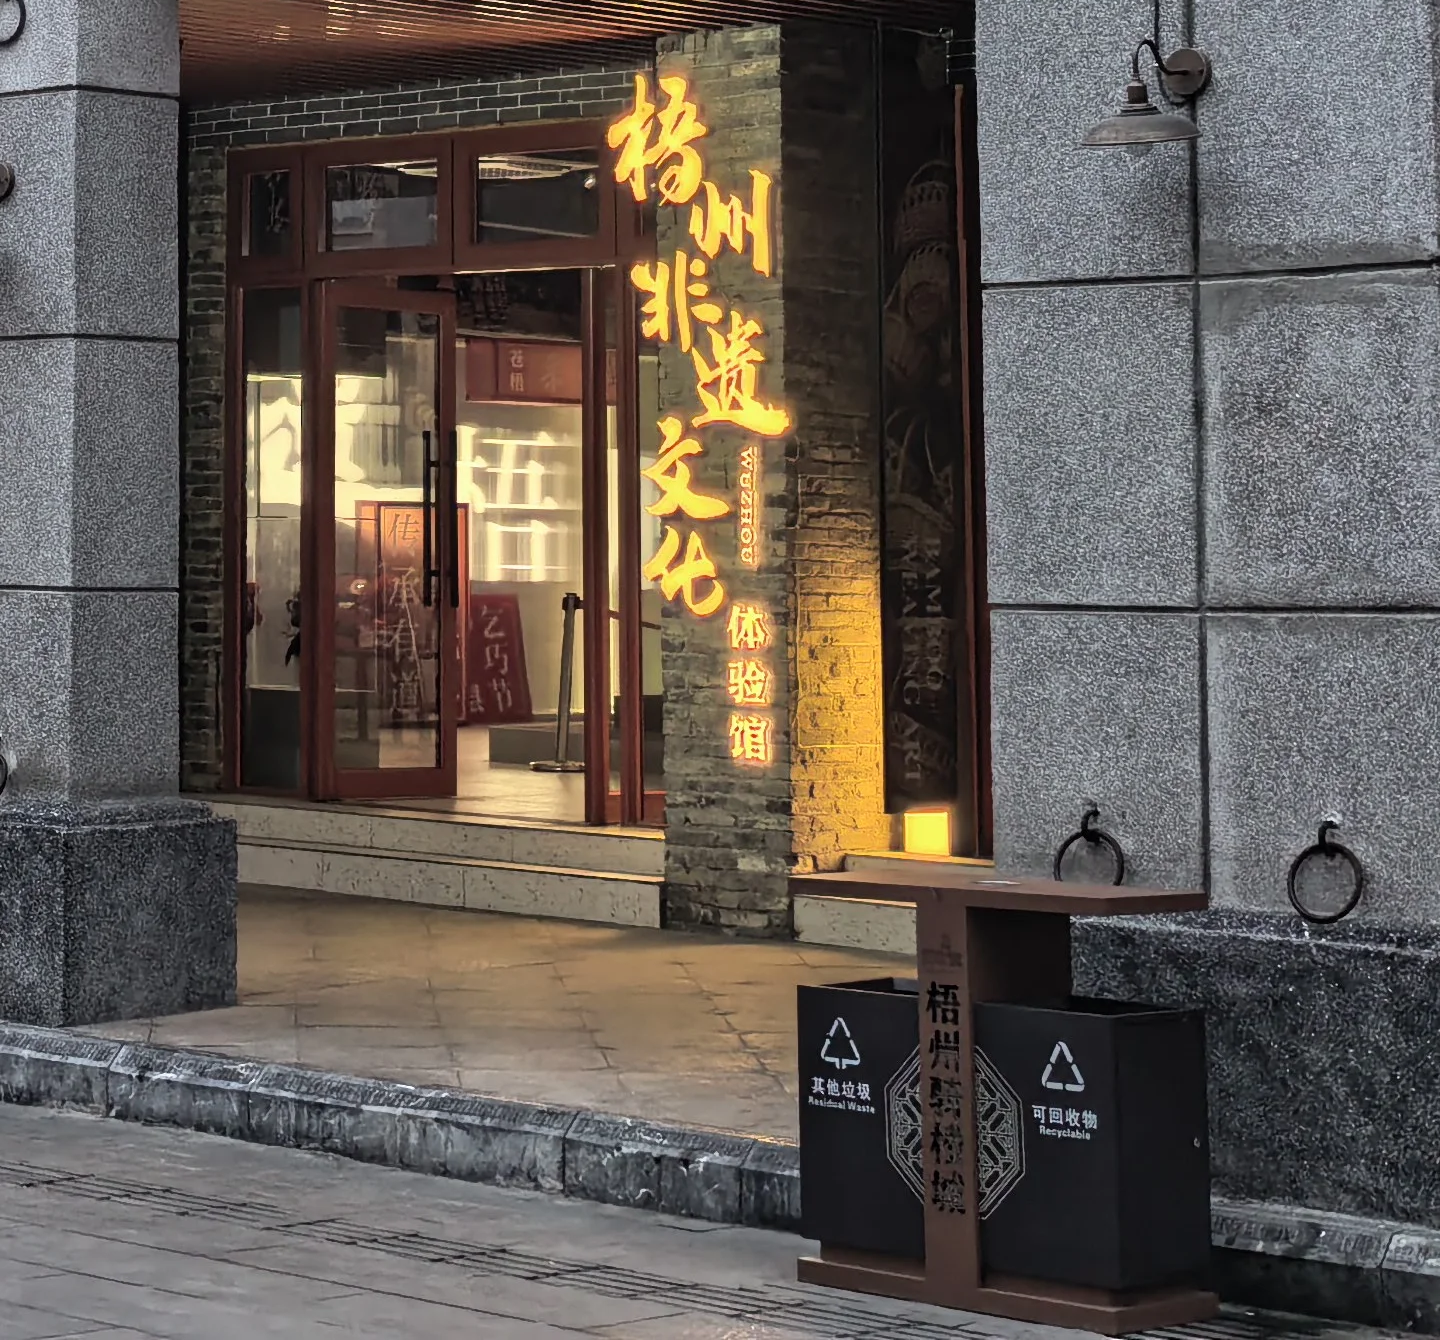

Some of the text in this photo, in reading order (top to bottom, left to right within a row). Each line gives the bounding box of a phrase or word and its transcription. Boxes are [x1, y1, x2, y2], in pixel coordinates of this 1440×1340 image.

[607, 76, 791, 617] 梧州非遗文化
[728, 603, 773, 760] 体验馆
[810, 1076, 871, 1100] 其他垃圾
[808, 1096, 876, 1114] Residual Waste
[1031, 1104, 1098, 1130] 可回收物
[1039, 1125, 1091, 1140] Recyclable
